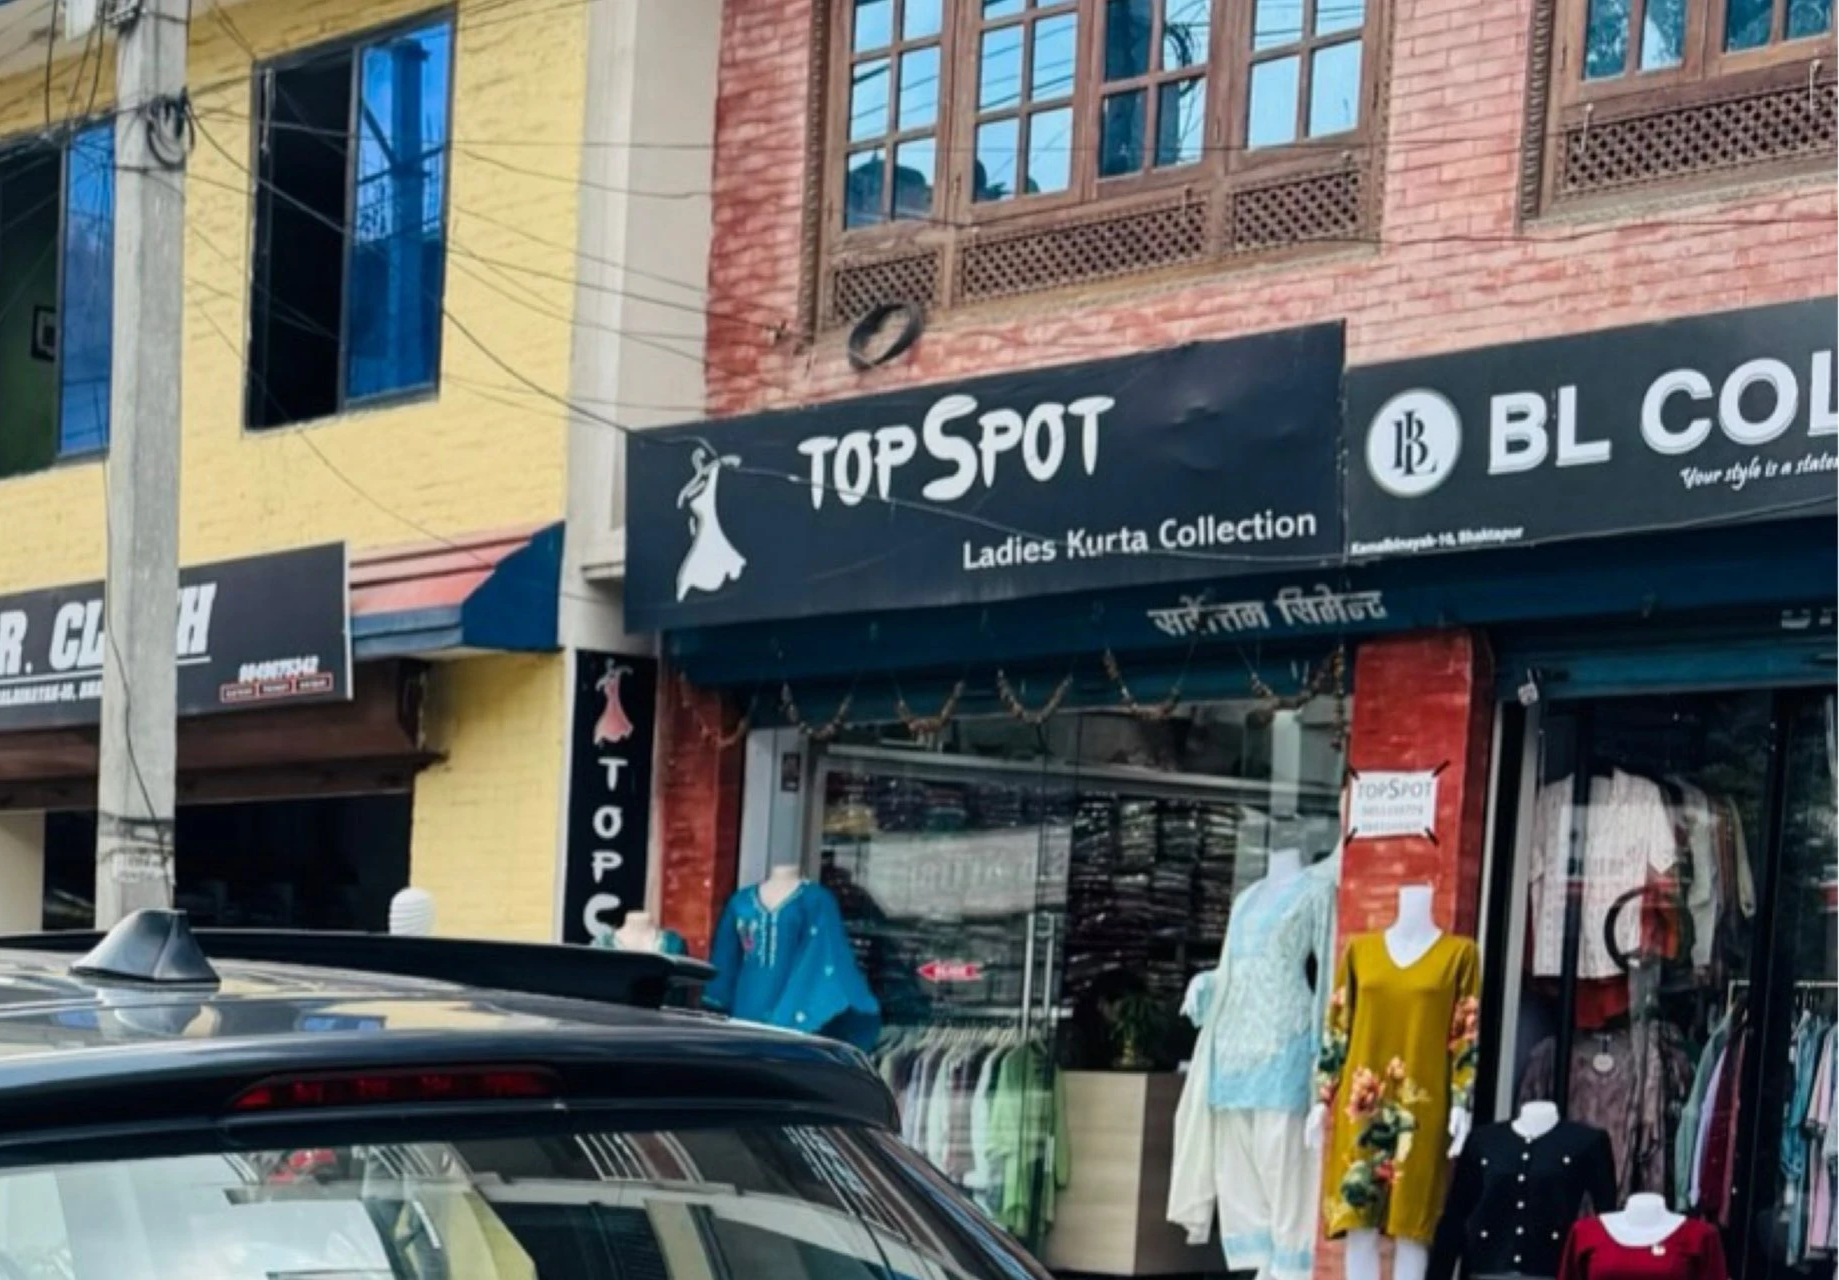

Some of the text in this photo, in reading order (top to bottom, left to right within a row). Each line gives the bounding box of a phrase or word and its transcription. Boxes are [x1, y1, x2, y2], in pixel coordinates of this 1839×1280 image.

[1488, 385, 1612, 475] BL
[1679, 467, 1722, 490] Your
[1723, 455, 1762, 491] style
[1765, 459, 1778, 477] is
[1780, 462, 1793, 475] a
[963, 510, 1317, 570] Ladies Kurta Collection
